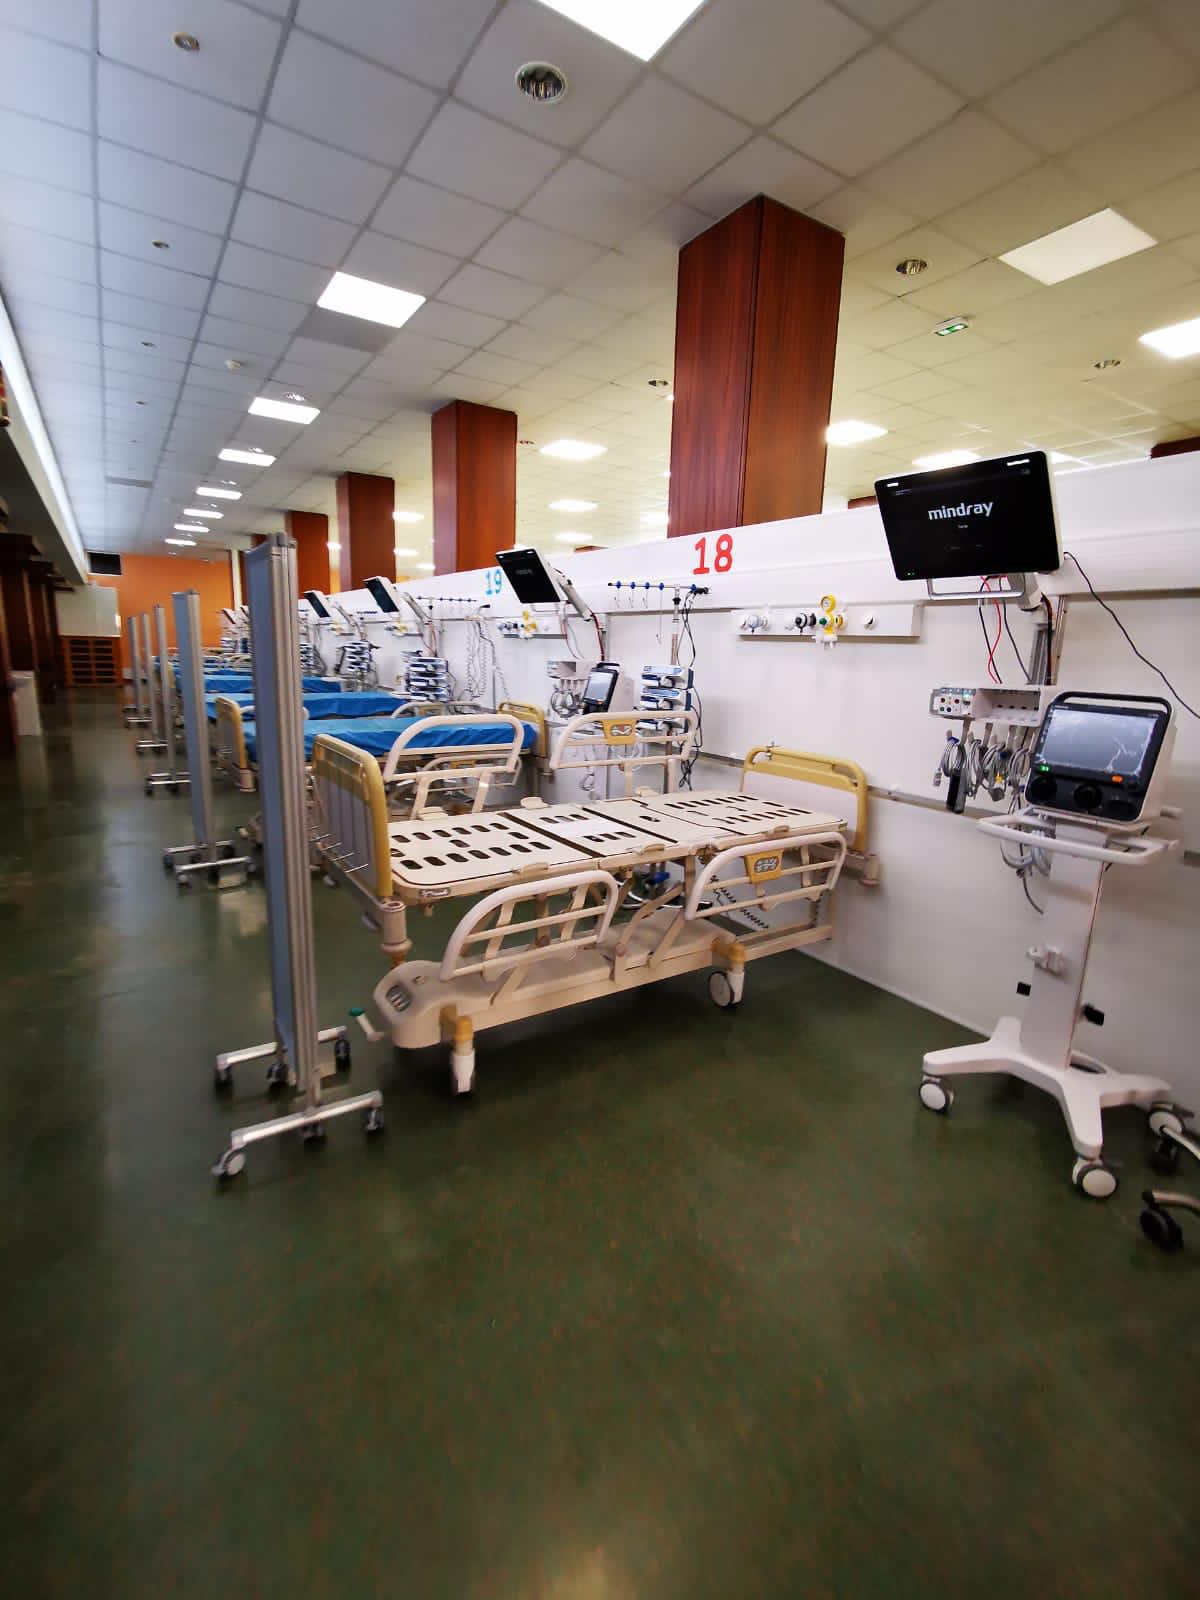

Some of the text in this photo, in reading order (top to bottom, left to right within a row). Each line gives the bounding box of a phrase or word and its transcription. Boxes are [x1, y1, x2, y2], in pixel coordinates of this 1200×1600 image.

[927, 500, 994, 521] mindray
[692, 533, 734, 575] 18
[485, 569, 503, 596] 19
